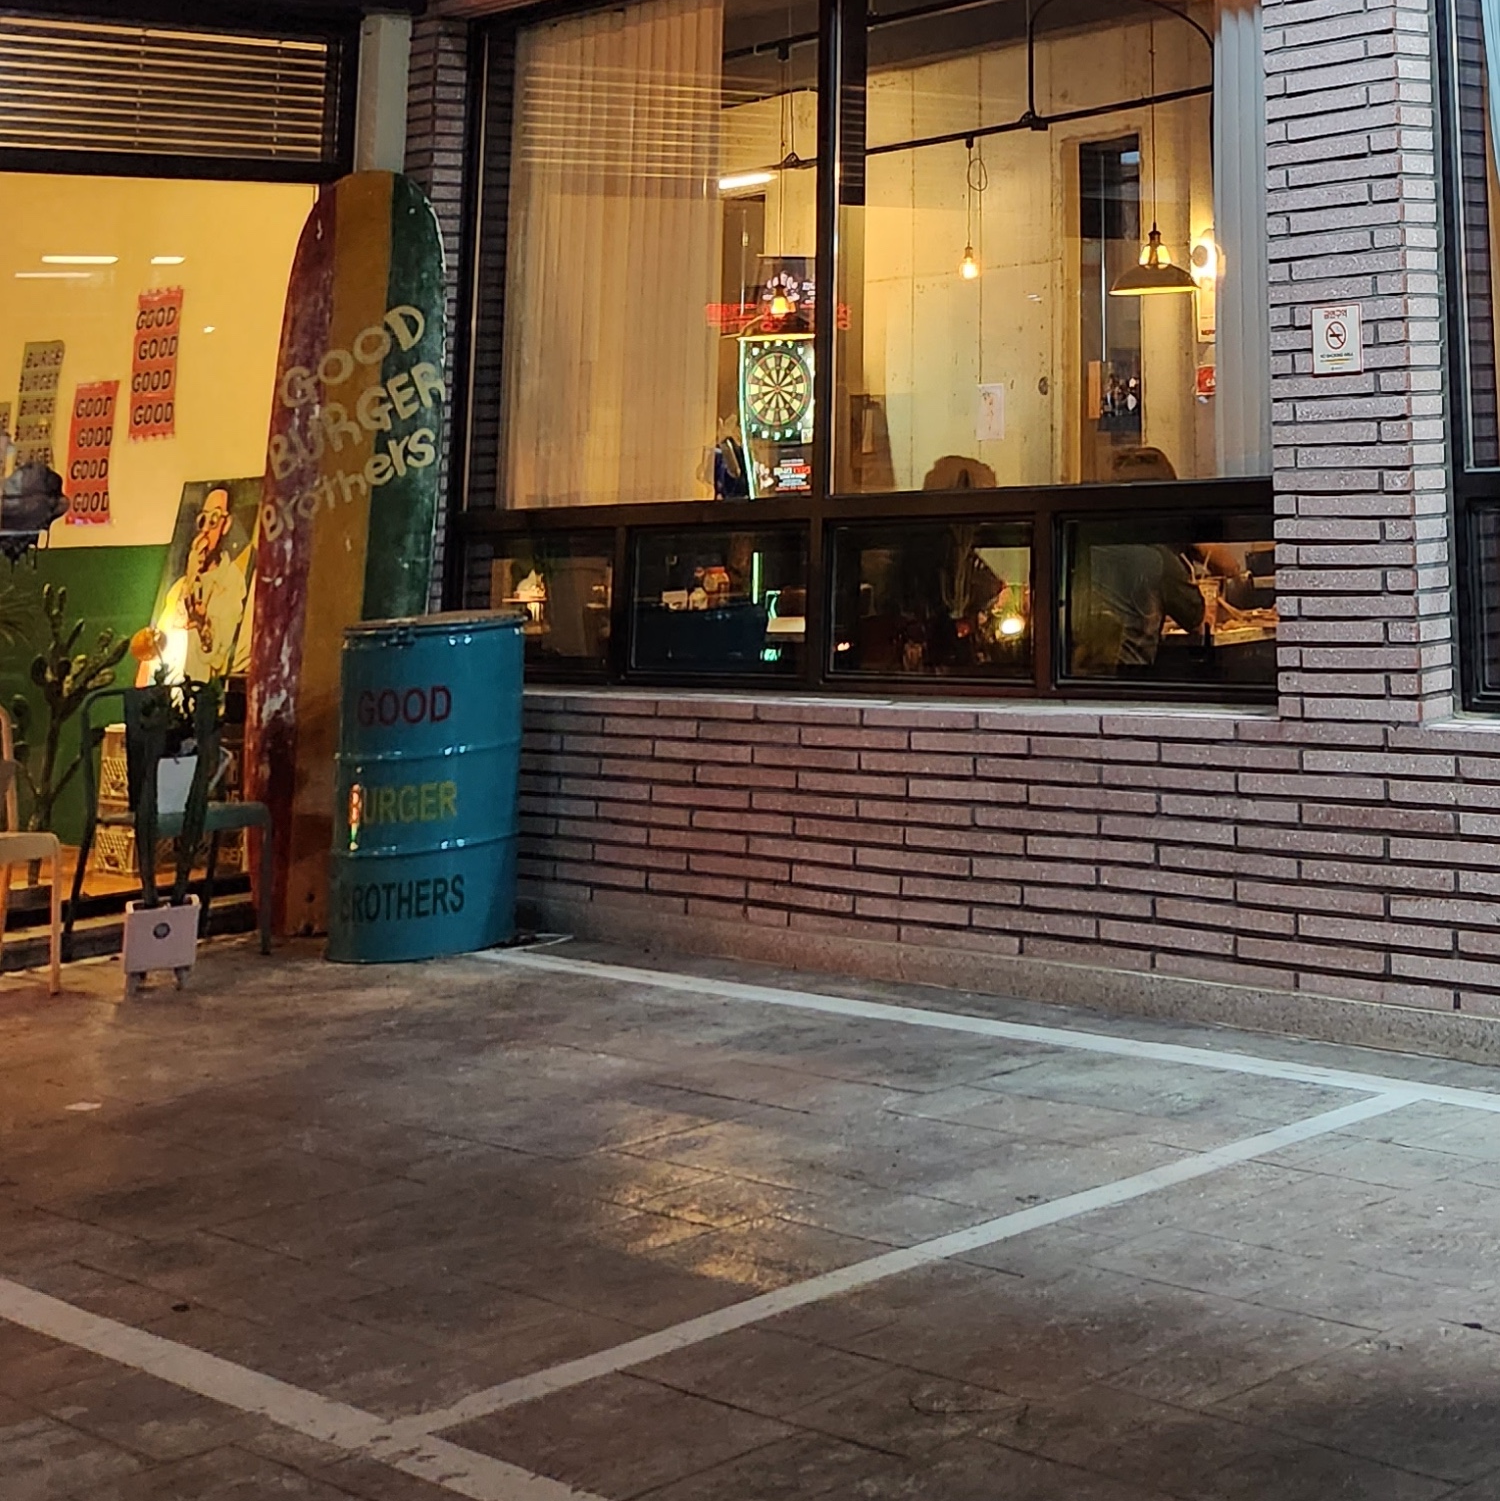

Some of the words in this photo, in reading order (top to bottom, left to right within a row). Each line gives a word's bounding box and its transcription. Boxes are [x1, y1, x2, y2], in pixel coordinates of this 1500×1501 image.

[136, 306, 177, 330] GOOD
[138, 335, 178, 360] GOOD
[281, 304, 426, 408] GOOD
[131, 369, 171, 393] GOOD
[133, 402, 174, 426] GOOD
[269, 361, 446, 481] BURGER
[77, 426, 113, 448] GOOD
[70, 458, 109, 480] GOOD
[72, 491, 110, 513] GOOD
[357, 685, 452, 728] GOOD
[349, 779, 458, 826] URGER
